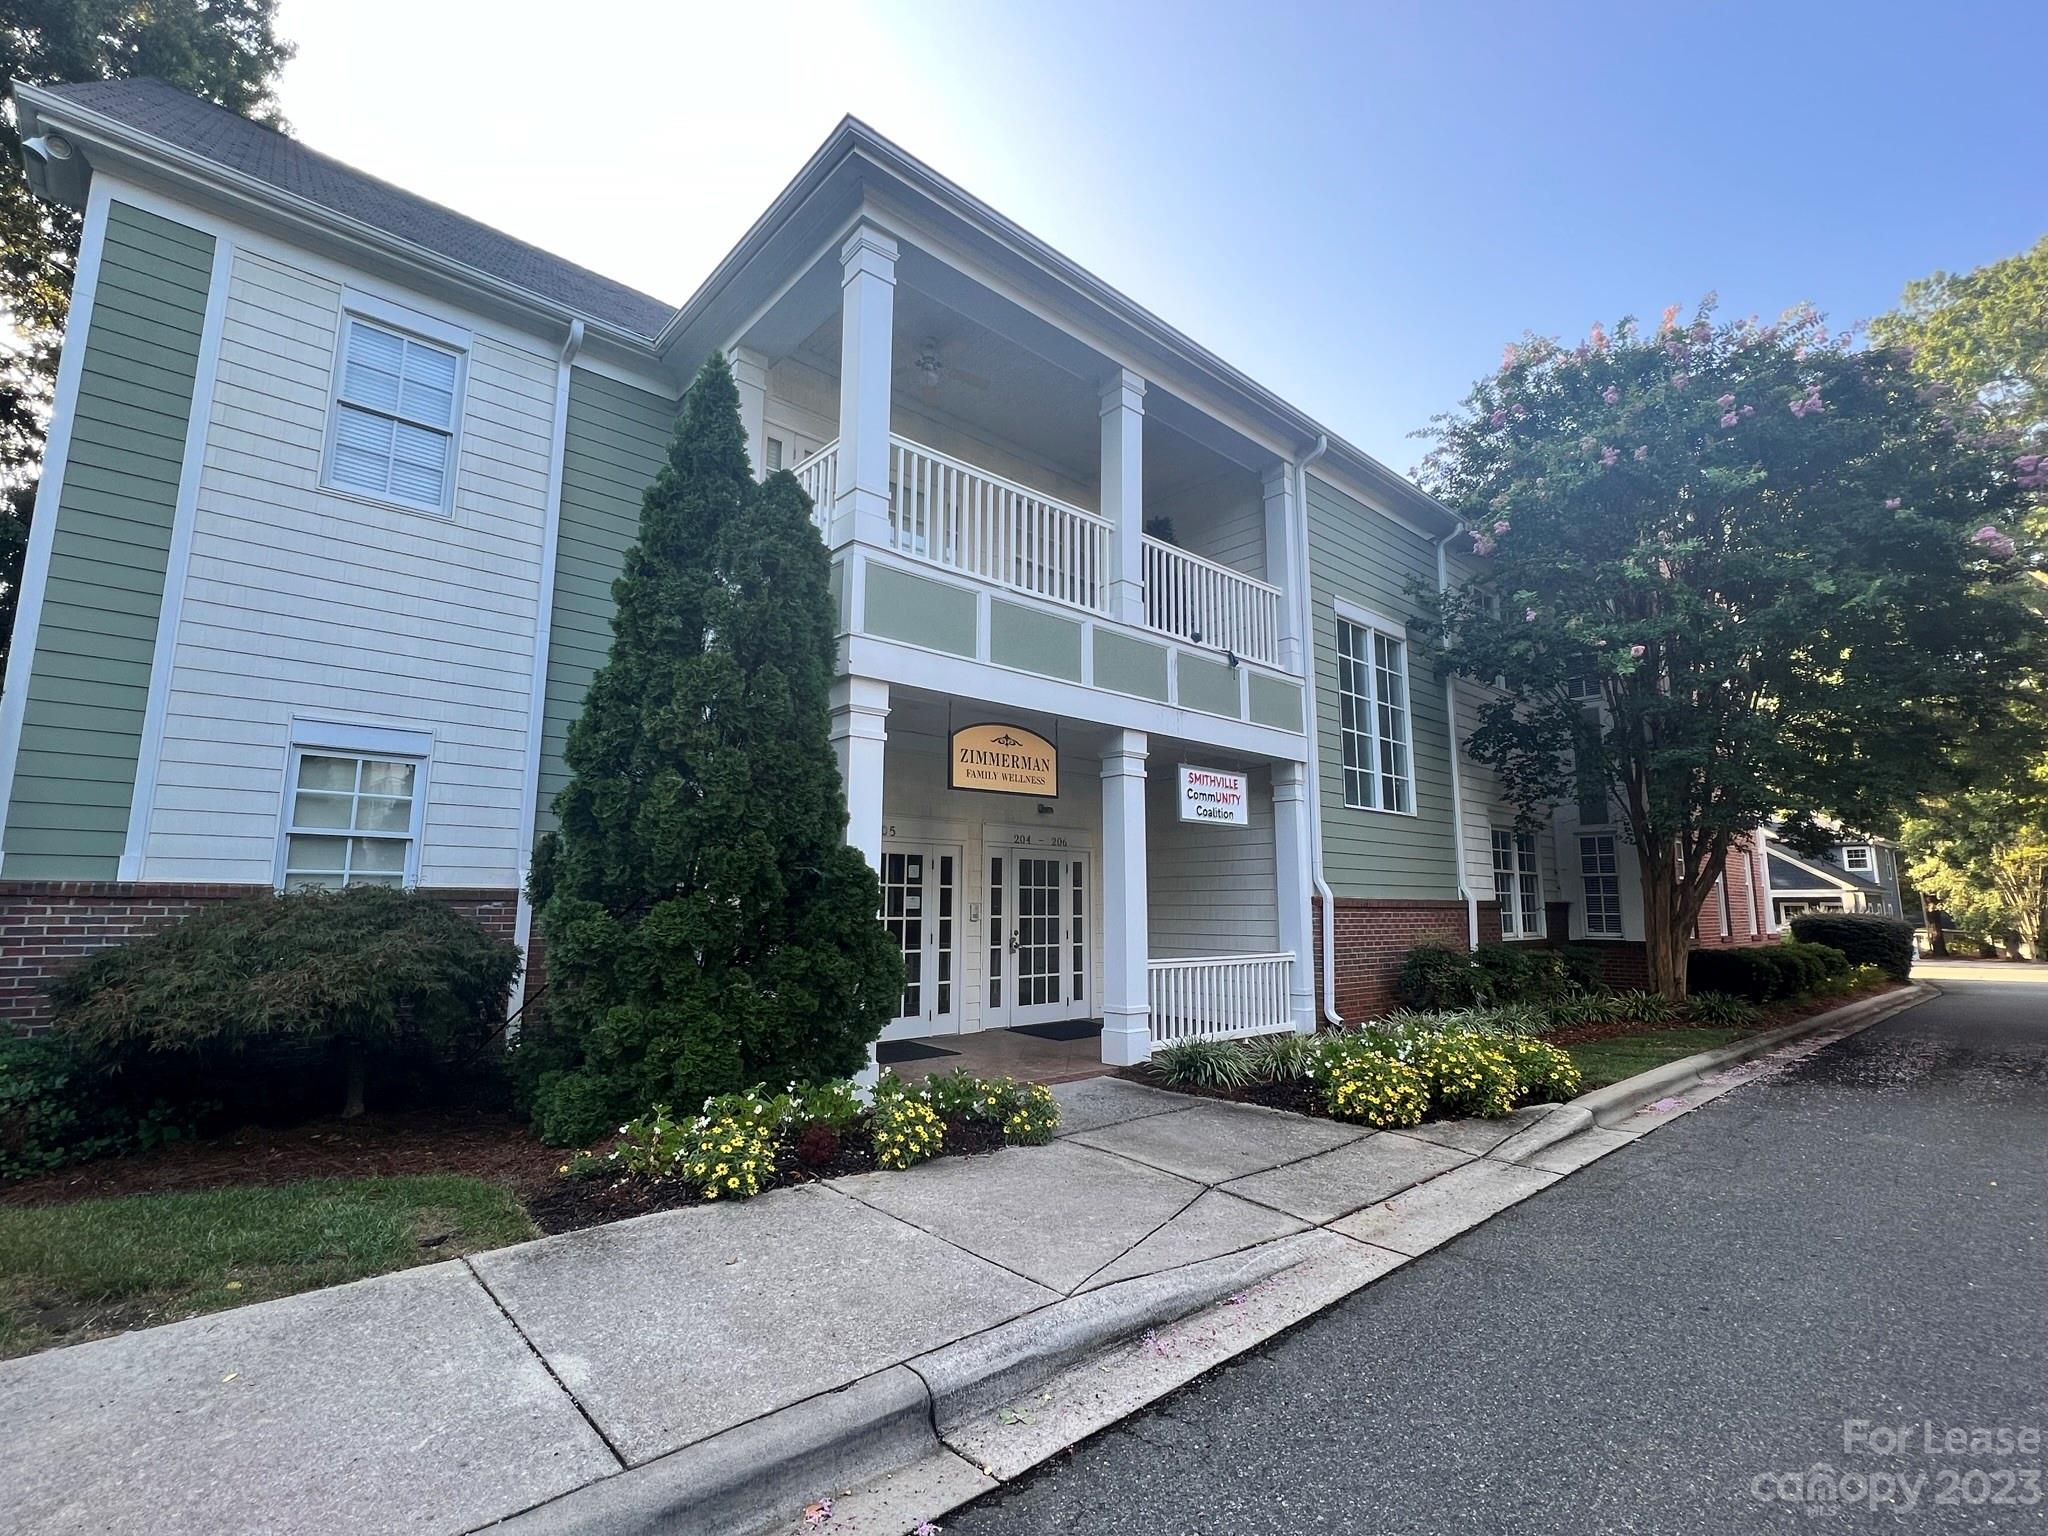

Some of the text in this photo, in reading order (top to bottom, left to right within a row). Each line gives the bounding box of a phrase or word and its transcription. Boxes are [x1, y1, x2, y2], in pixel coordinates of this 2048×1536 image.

[960, 748, 1050, 772] ZIMMERMAN
[966, 768, 1046, 786] FAMILY WELLNESS
[1188, 772, 1239, 790] SMITHVILLE
[1187, 788, 1241, 805] CommUNITY
[1196, 805, 1234, 820] Coalition
[1014, 834, 1031, 845] 204
[1051, 837, 1068, 847] 206
